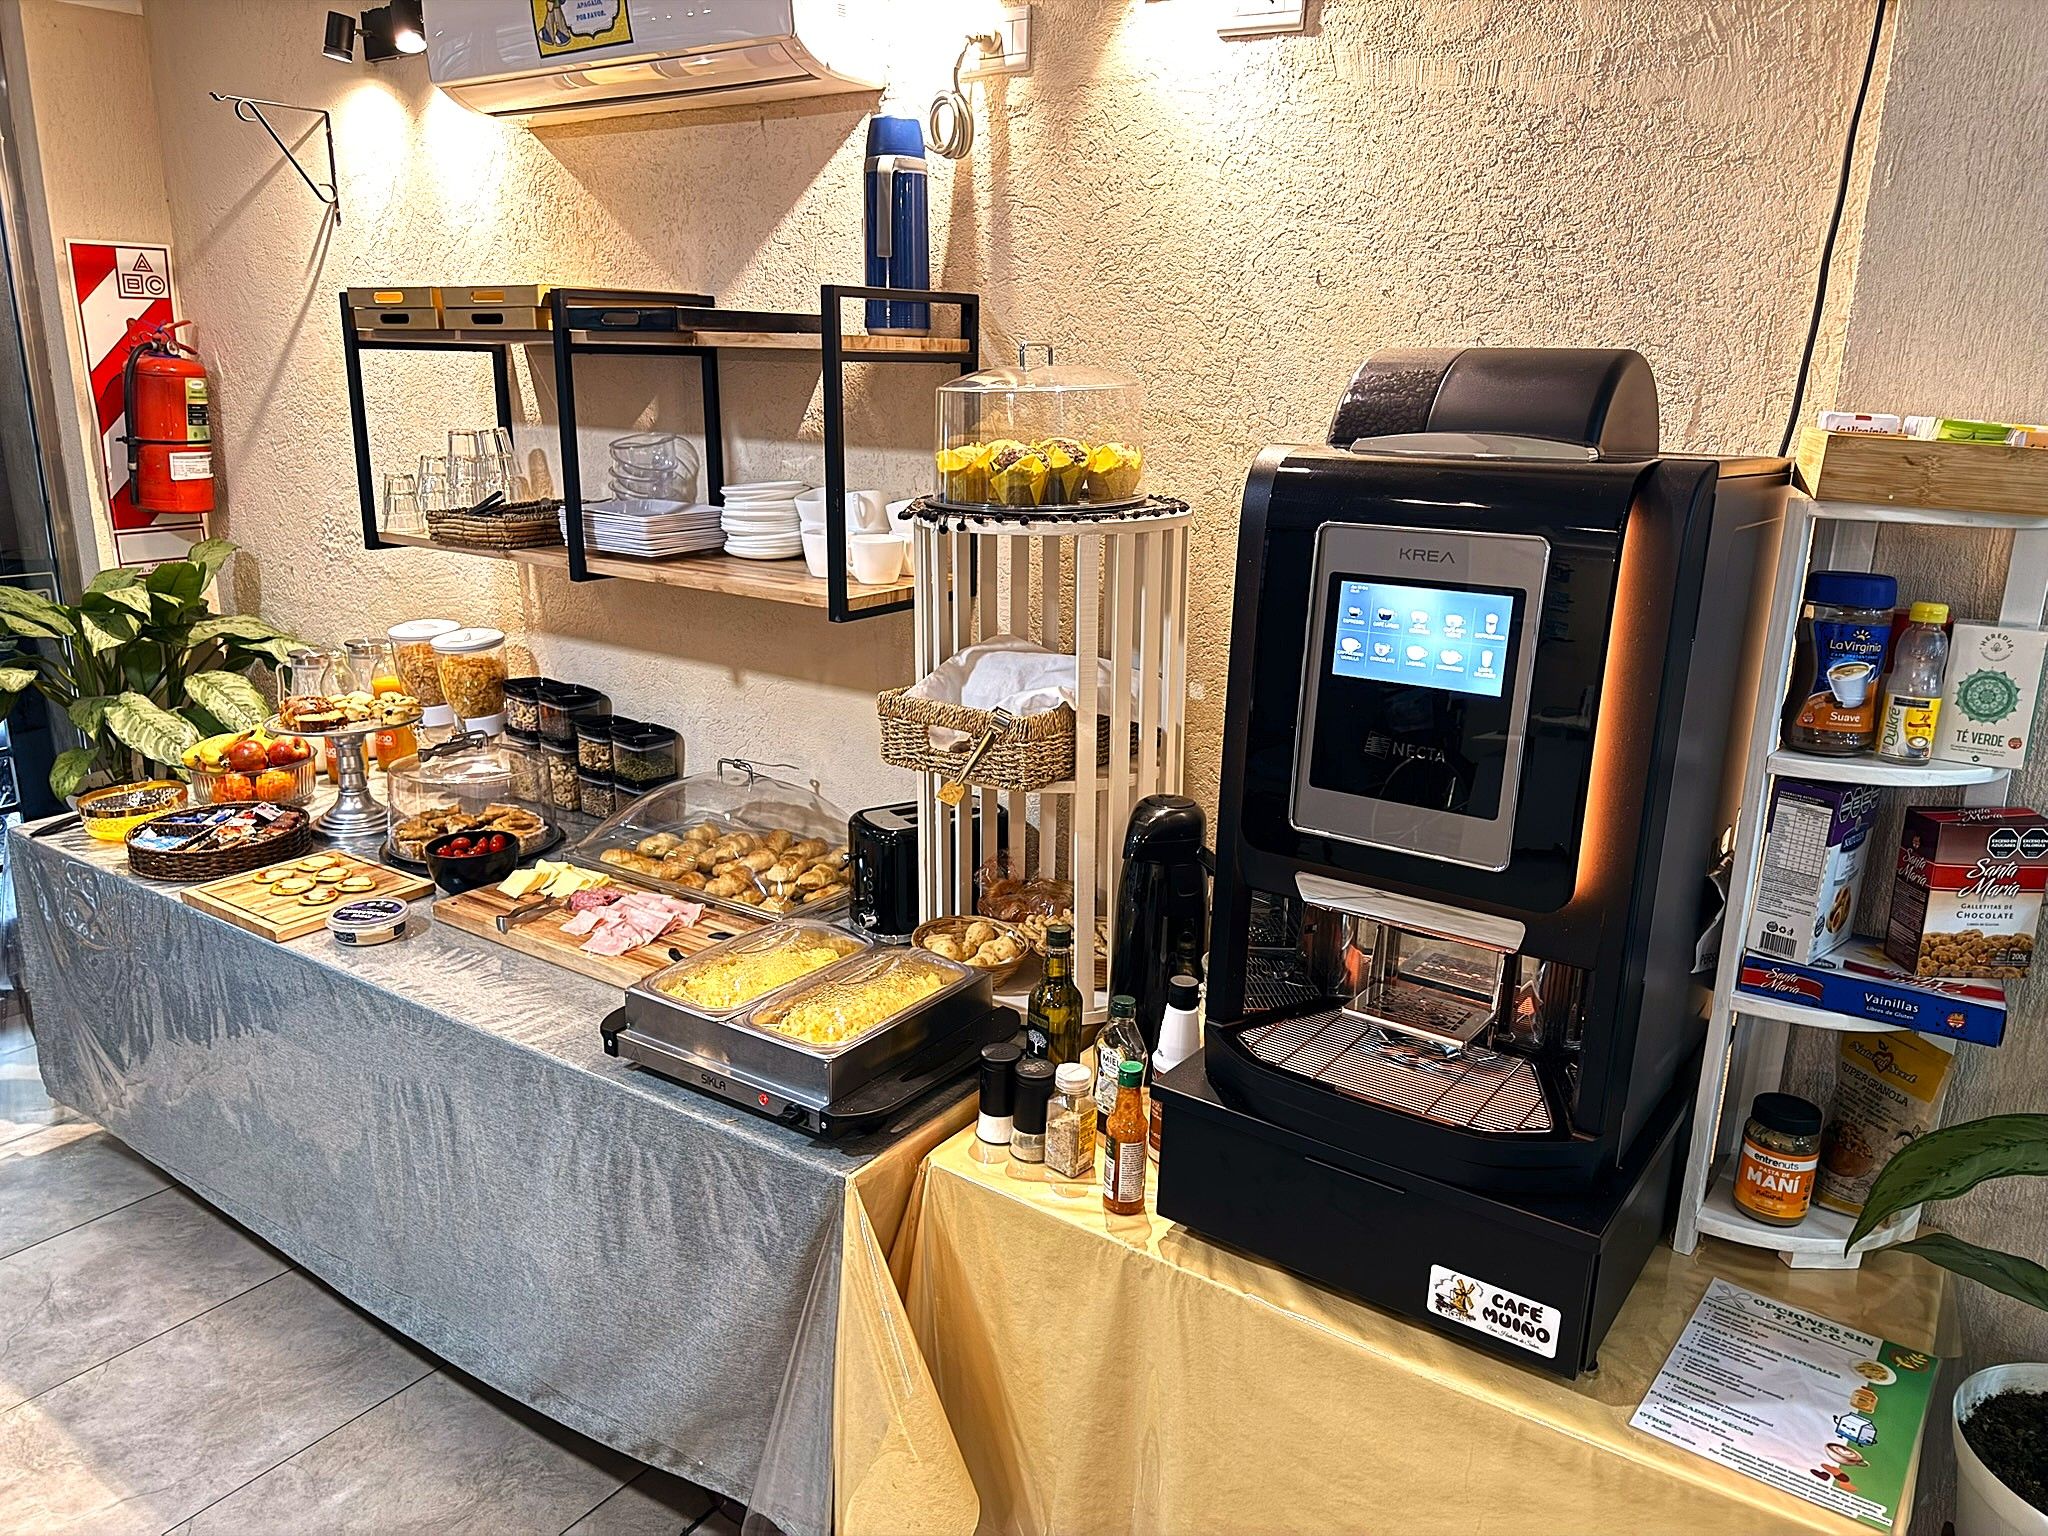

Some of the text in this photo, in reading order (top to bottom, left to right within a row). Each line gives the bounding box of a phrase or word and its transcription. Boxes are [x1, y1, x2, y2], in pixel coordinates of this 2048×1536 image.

[1830, 711, 1861, 722] Suave
[1956, 728, 2005, 748] TÉ VERDE
[1393, 741, 1446, 763] NECTA
[1958, 808, 1991, 816] Santa
[1903, 848, 1926, 870] Santa
[1966, 858, 2019, 879] Santa
[1957, 877, 2021, 902] María
[1956, 910, 2015, 920] CHOCOLATE
[1766, 968, 1800, 983] Santa
[1865, 992, 1919, 1013] Vainillas
[1866, 1006, 1884, 1014] Libres
[1894, 1012, 1914, 1020] Gluten
[1868, 1079, 1909, 1107] GRANOLA
[1754, 1152, 1800, 1171] entrenuts
[1759, 1166, 1780, 1177] PASTA
[1747, 1166, 1802, 1194] MANÍ
[1755, 1189, 1784, 1202] natural
[1491, 1294, 1544, 1324] CAFÉ
[1752, 1298, 1840, 1334] OPCIONES
[1482, 1307, 1551, 1344] MUIÑO
[1772, 1312, 1848, 1344] T.A.C.C.
[1736, 1337, 1782, 1356] OPCIONES
[1783, 1354, 1840, 1379] NATURALES
[1660, 1370, 1717, 1395] INFUSIONES
[1638, 1411, 1672, 1428] OTROS
[1720, 1418, 1754, 1436] SECOS
